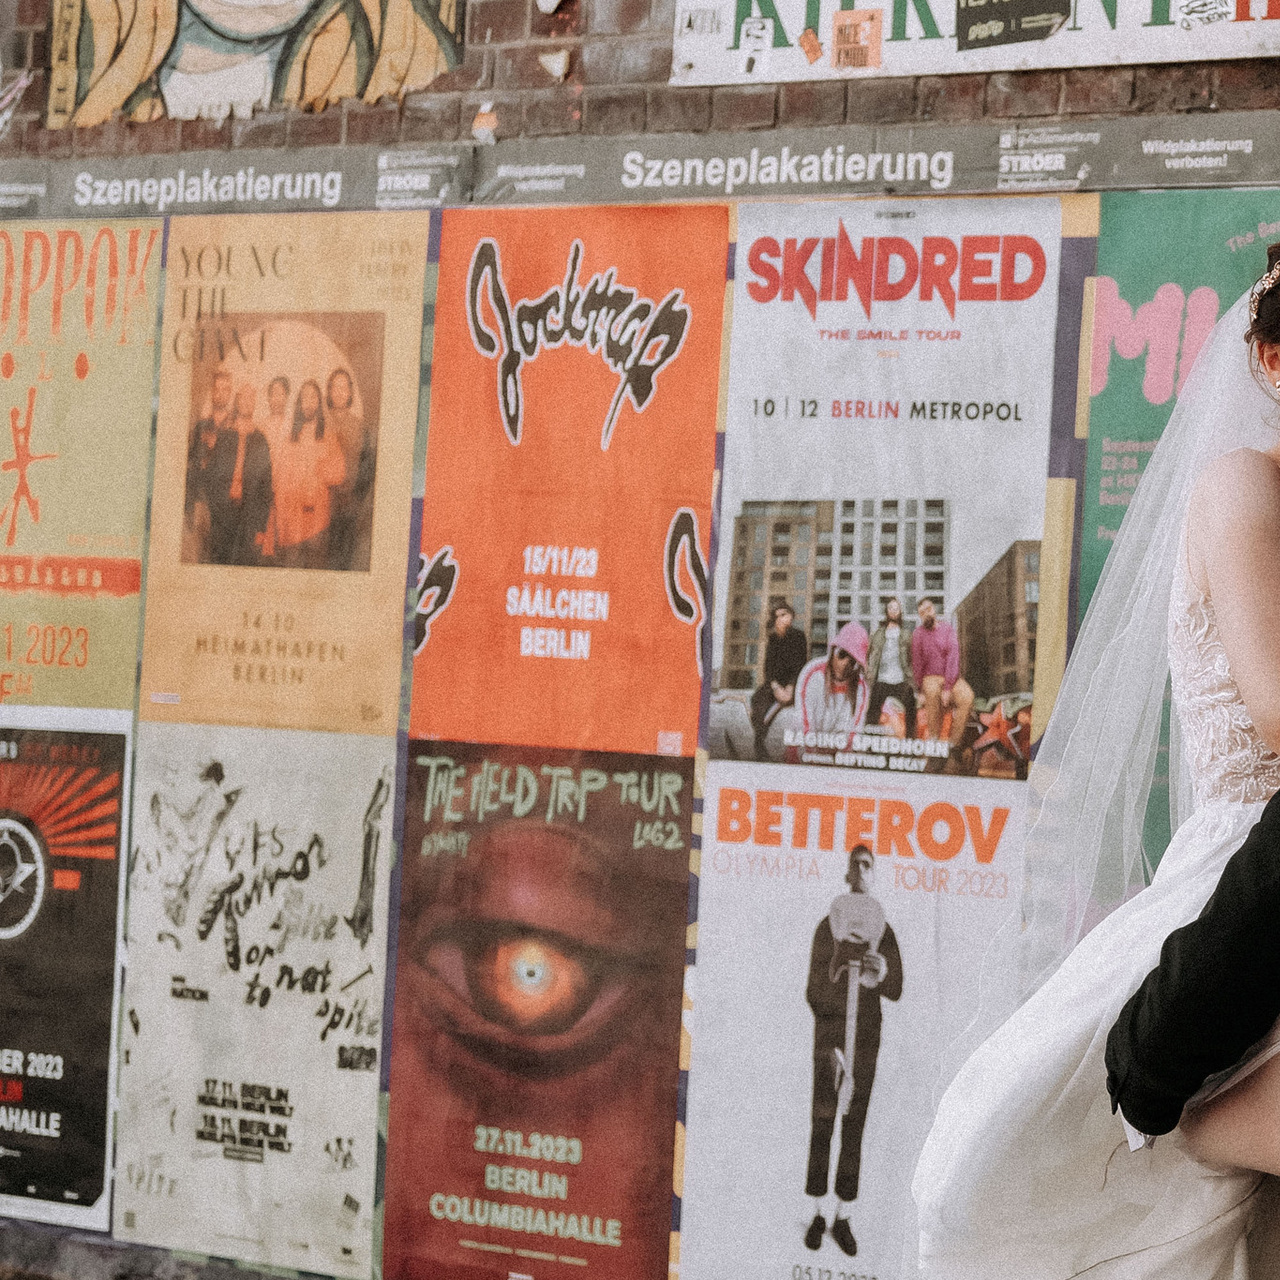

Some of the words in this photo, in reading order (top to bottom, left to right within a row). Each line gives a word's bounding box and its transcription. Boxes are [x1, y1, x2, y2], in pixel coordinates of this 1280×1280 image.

[620, 145, 955, 196] Szeneplakatierung
[73, 167, 343, 212] Szeneplakatierung
[745, 216, 1047, 323] SKINDRED
[819, 328, 849, 342] THE
[855, 328, 909, 342] SMILE
[915, 328, 962, 342] TOUR
[830, 400, 900, 419] BERLIN
[909, 401, 1022, 422] METROPOL
[519, 626, 591, 661] BERLIN
[416, 754, 466, 822] THE
[612, 770, 684, 817] TOUR
[716, 787, 1010, 864] BETTEROV
[711, 847, 822, 882] OLYMPIA
[894, 864, 950, 893] TOUR
[956, 869, 1010, 899] 2023
[0, 1048, 24, 1076] ER
[27, 1051, 64, 1080] 2023
[240, 1081, 290, 1104] BERLIN
[238, 1118, 288, 1140] BERLIN
[474, 1125, 583, 1165] 27.11.2023
[484, 1164, 568, 1200] BERLIN
[429, 1192, 622, 1247] COLUMBIAHALLE
